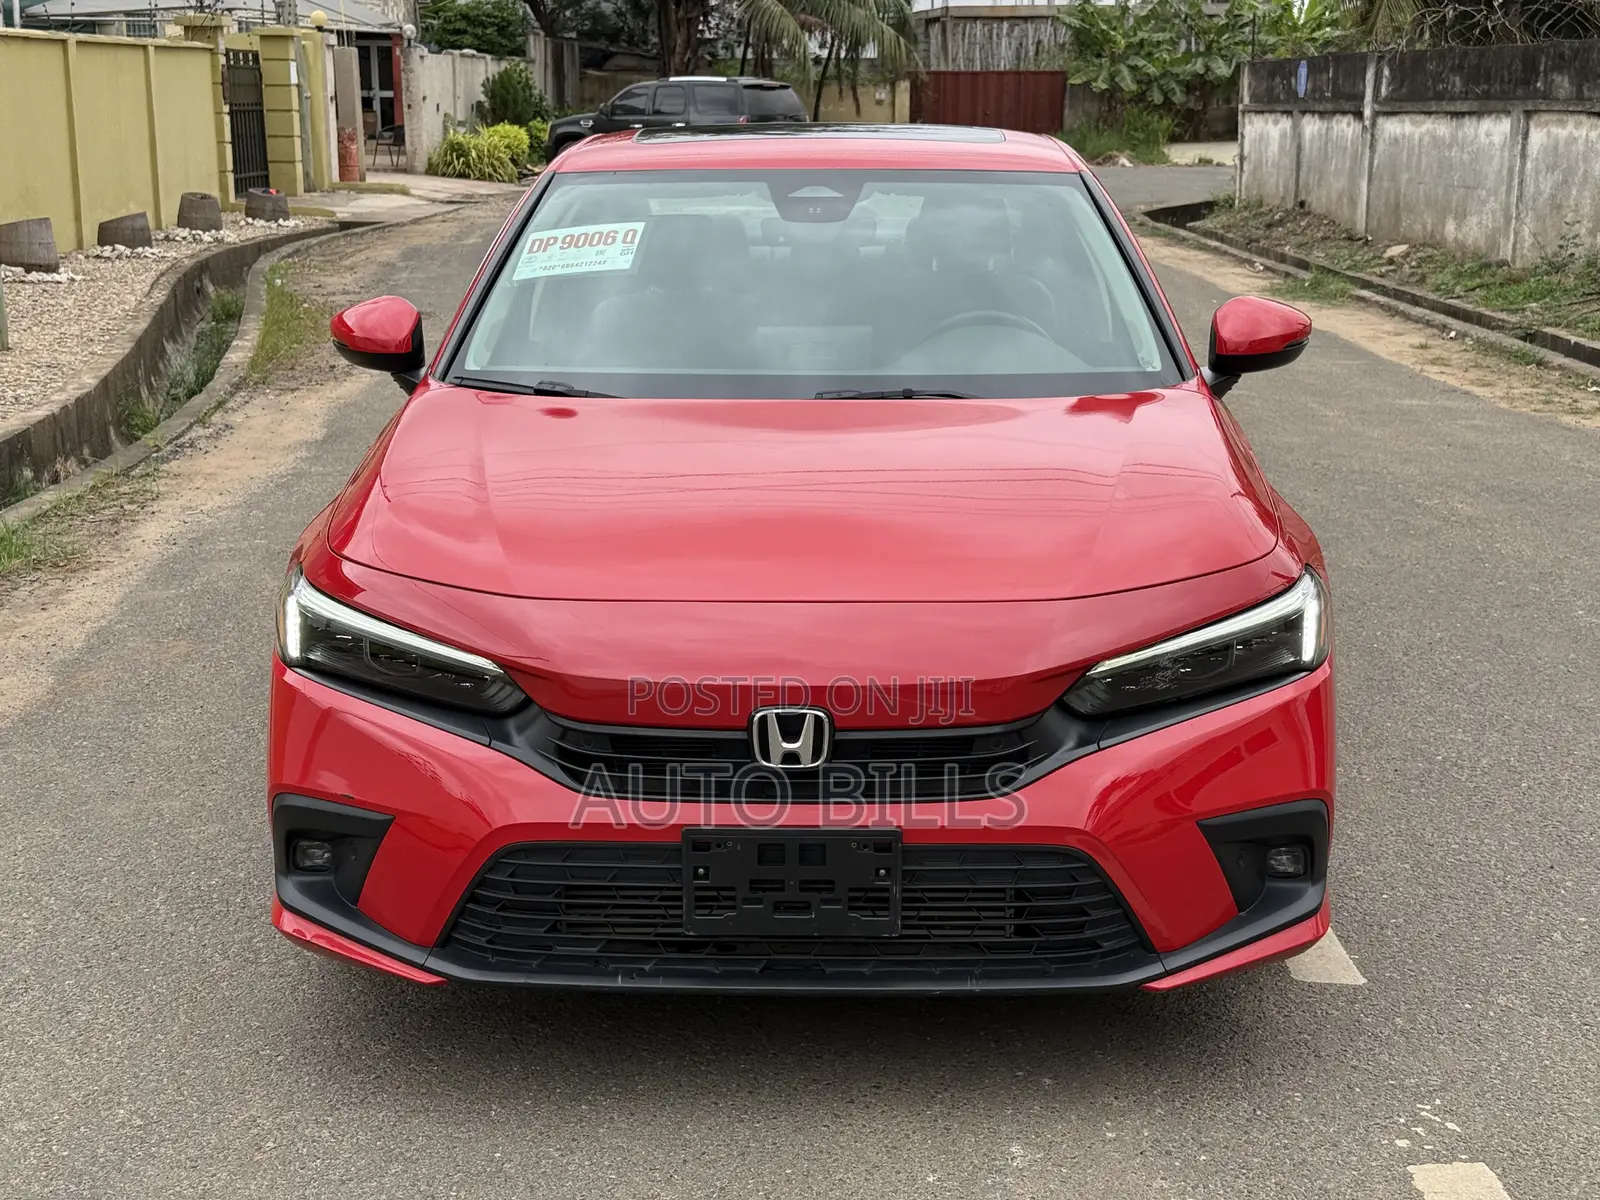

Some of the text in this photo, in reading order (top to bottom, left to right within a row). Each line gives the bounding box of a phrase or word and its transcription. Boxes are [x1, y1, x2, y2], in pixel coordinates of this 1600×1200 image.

[527, 228, 638, 254] DP 9006 Q
